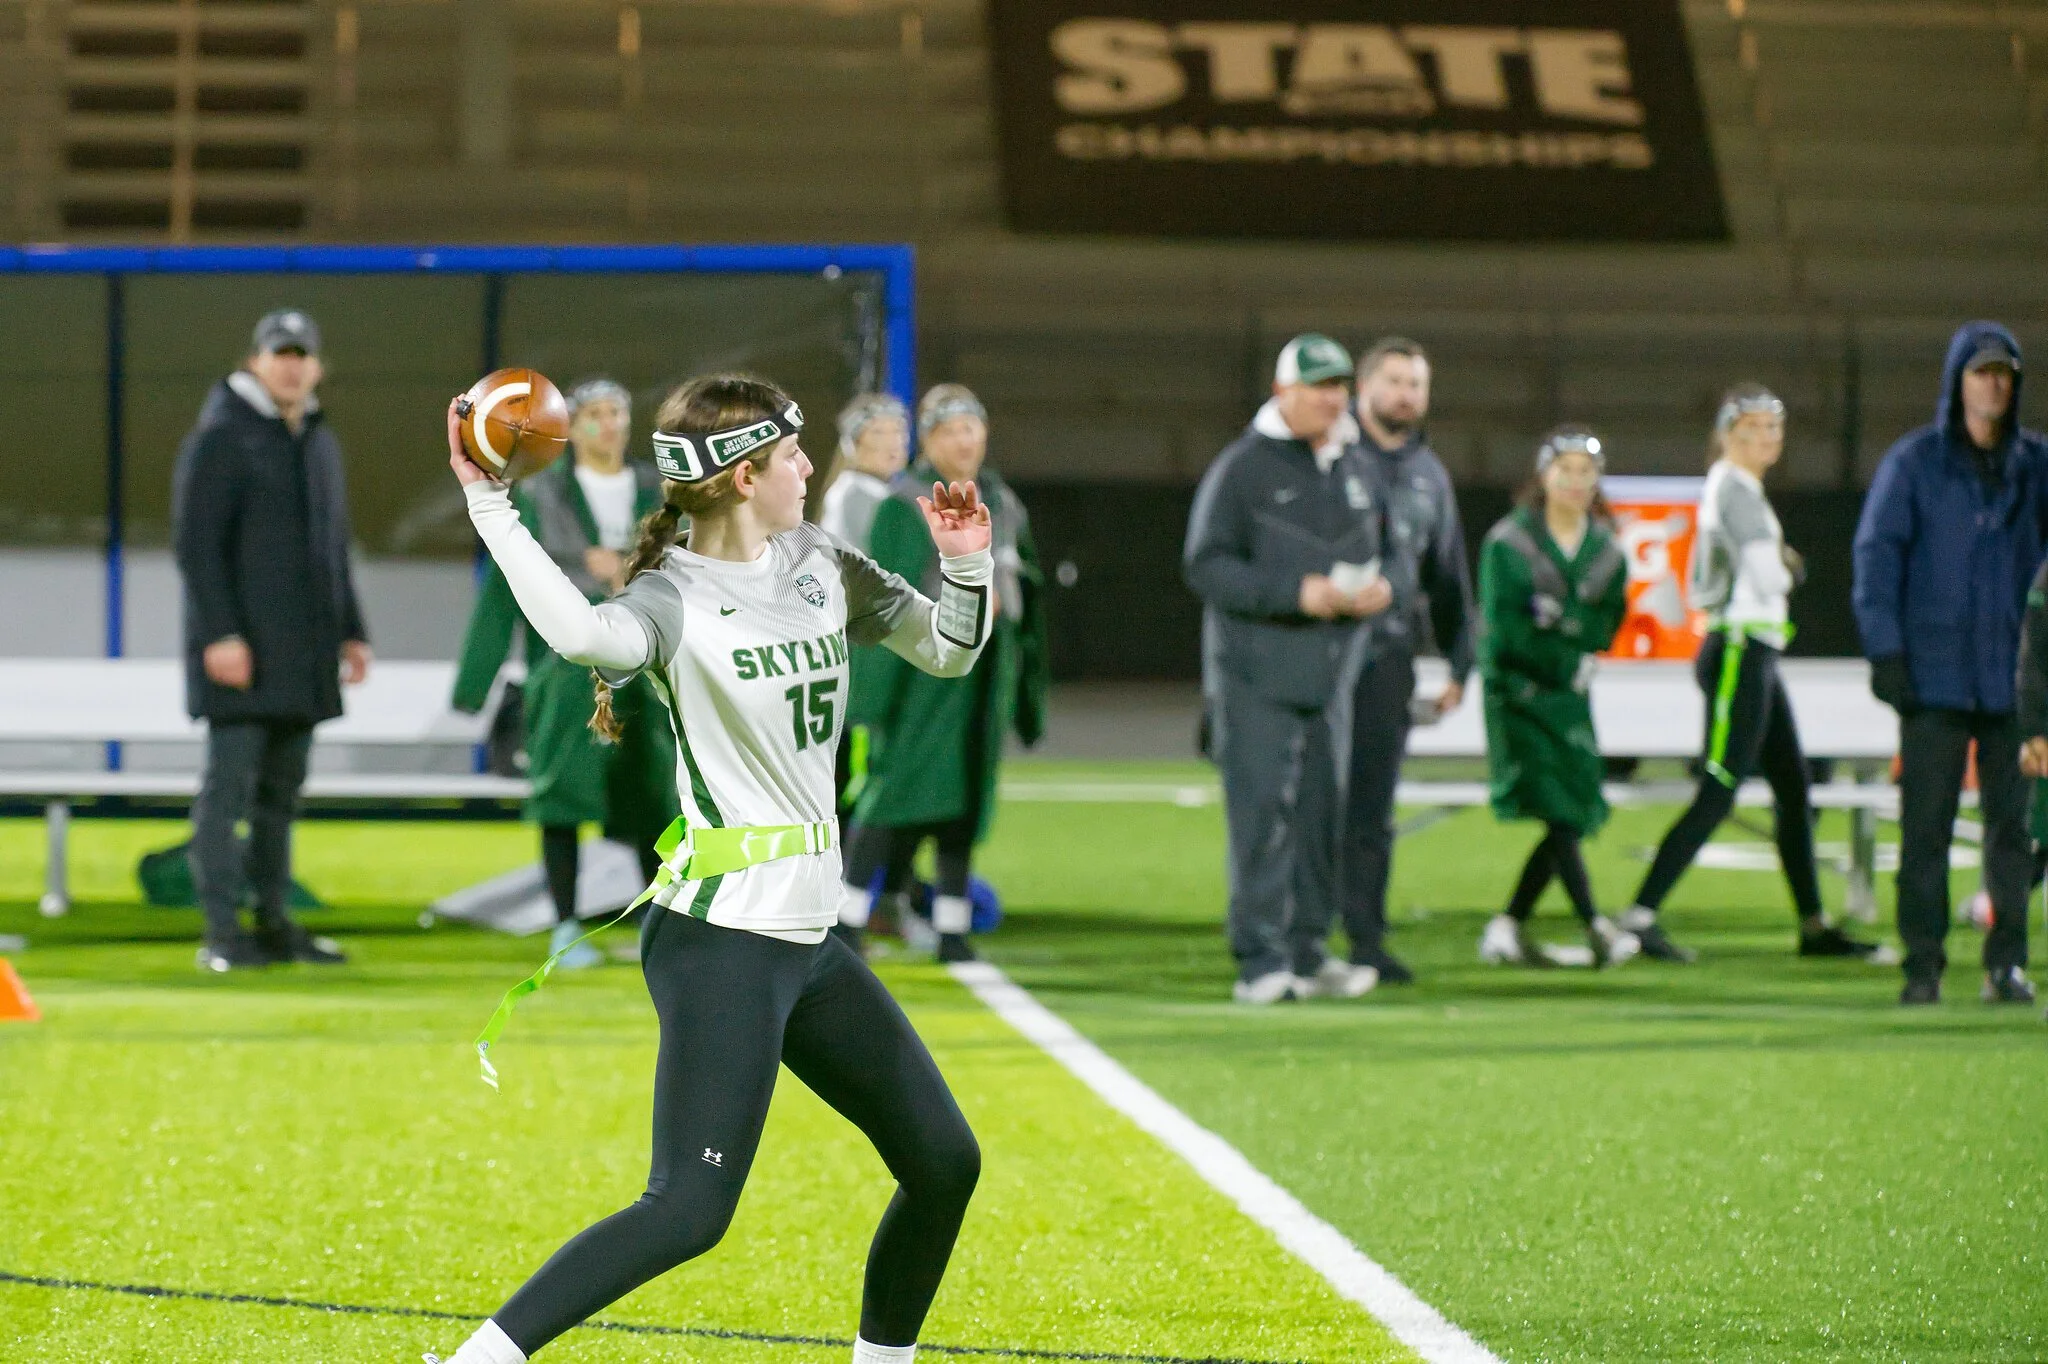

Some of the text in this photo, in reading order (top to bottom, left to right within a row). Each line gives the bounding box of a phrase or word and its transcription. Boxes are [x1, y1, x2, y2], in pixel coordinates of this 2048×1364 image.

[1049, 17, 1644, 126] STATE
[1055, 123, 1653, 171] CHAMPIONSHIPS
[731, 628, 848, 681] SKYLIN
[784, 677, 839, 752] 15
